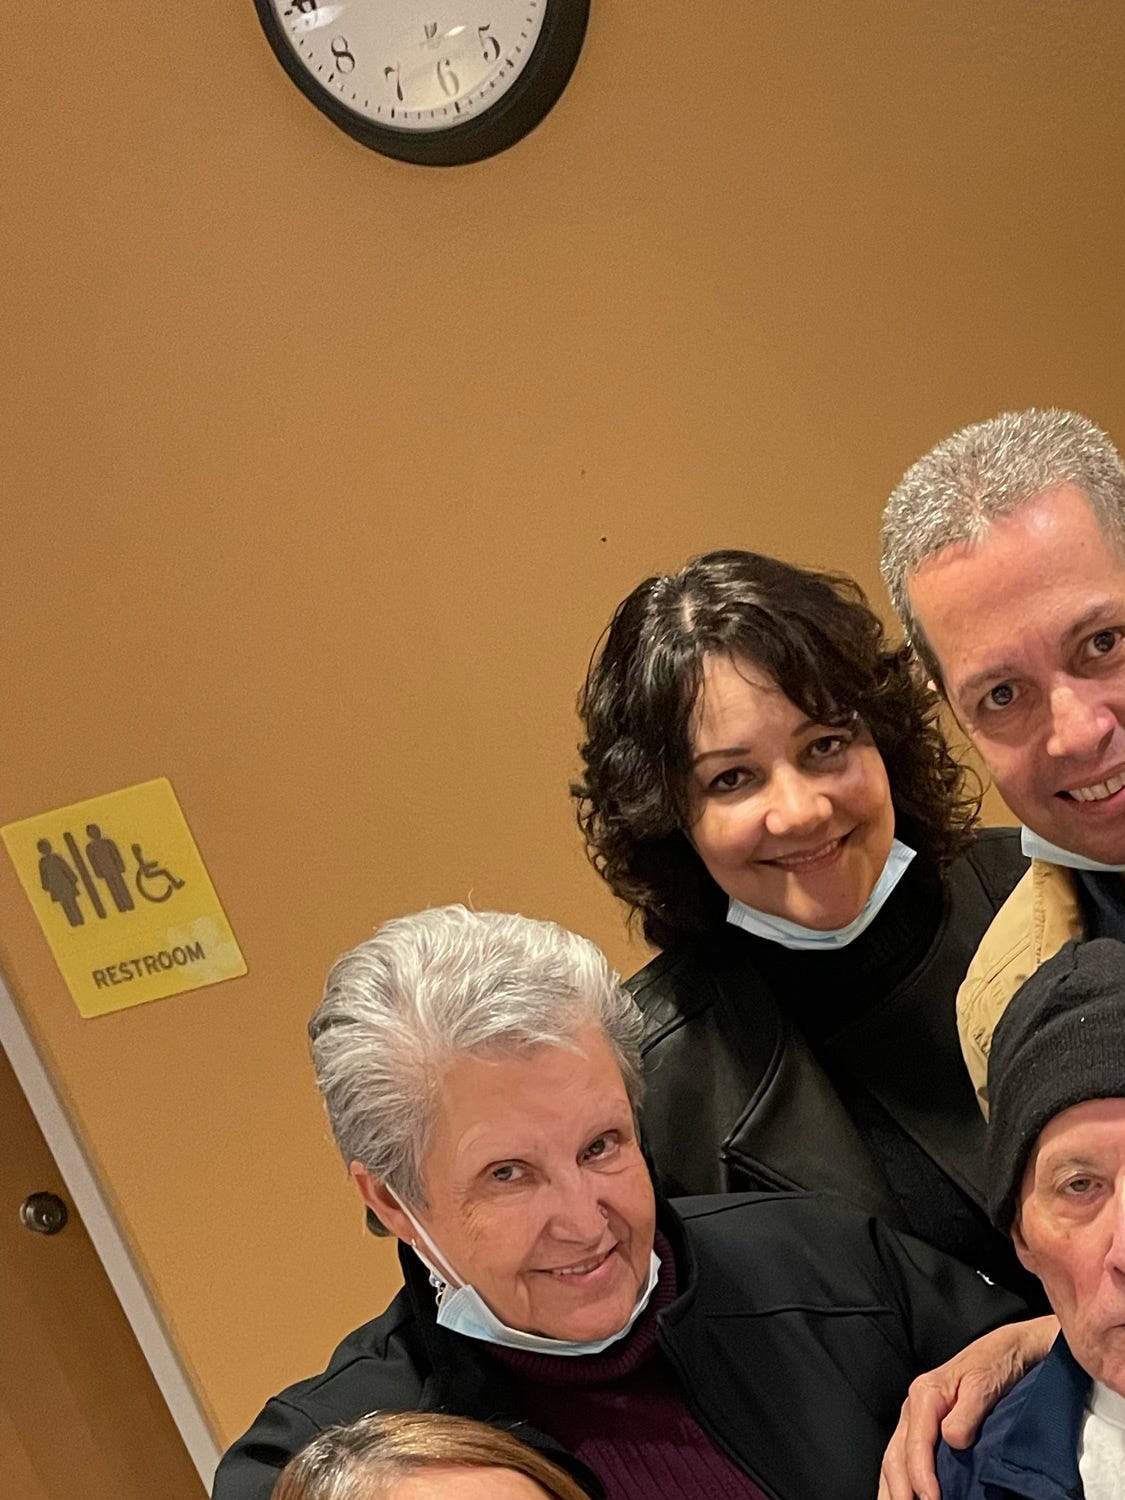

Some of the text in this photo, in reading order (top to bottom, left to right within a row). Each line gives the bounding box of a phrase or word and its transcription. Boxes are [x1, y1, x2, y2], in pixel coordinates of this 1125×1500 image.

[330, 36, 355, 74] 8
[478, 24, 500, 62] 5
[384, 61, 403, 101] 7
[437, 58, 460, 97] 6
[91, 941, 206, 989] RESTROOM
